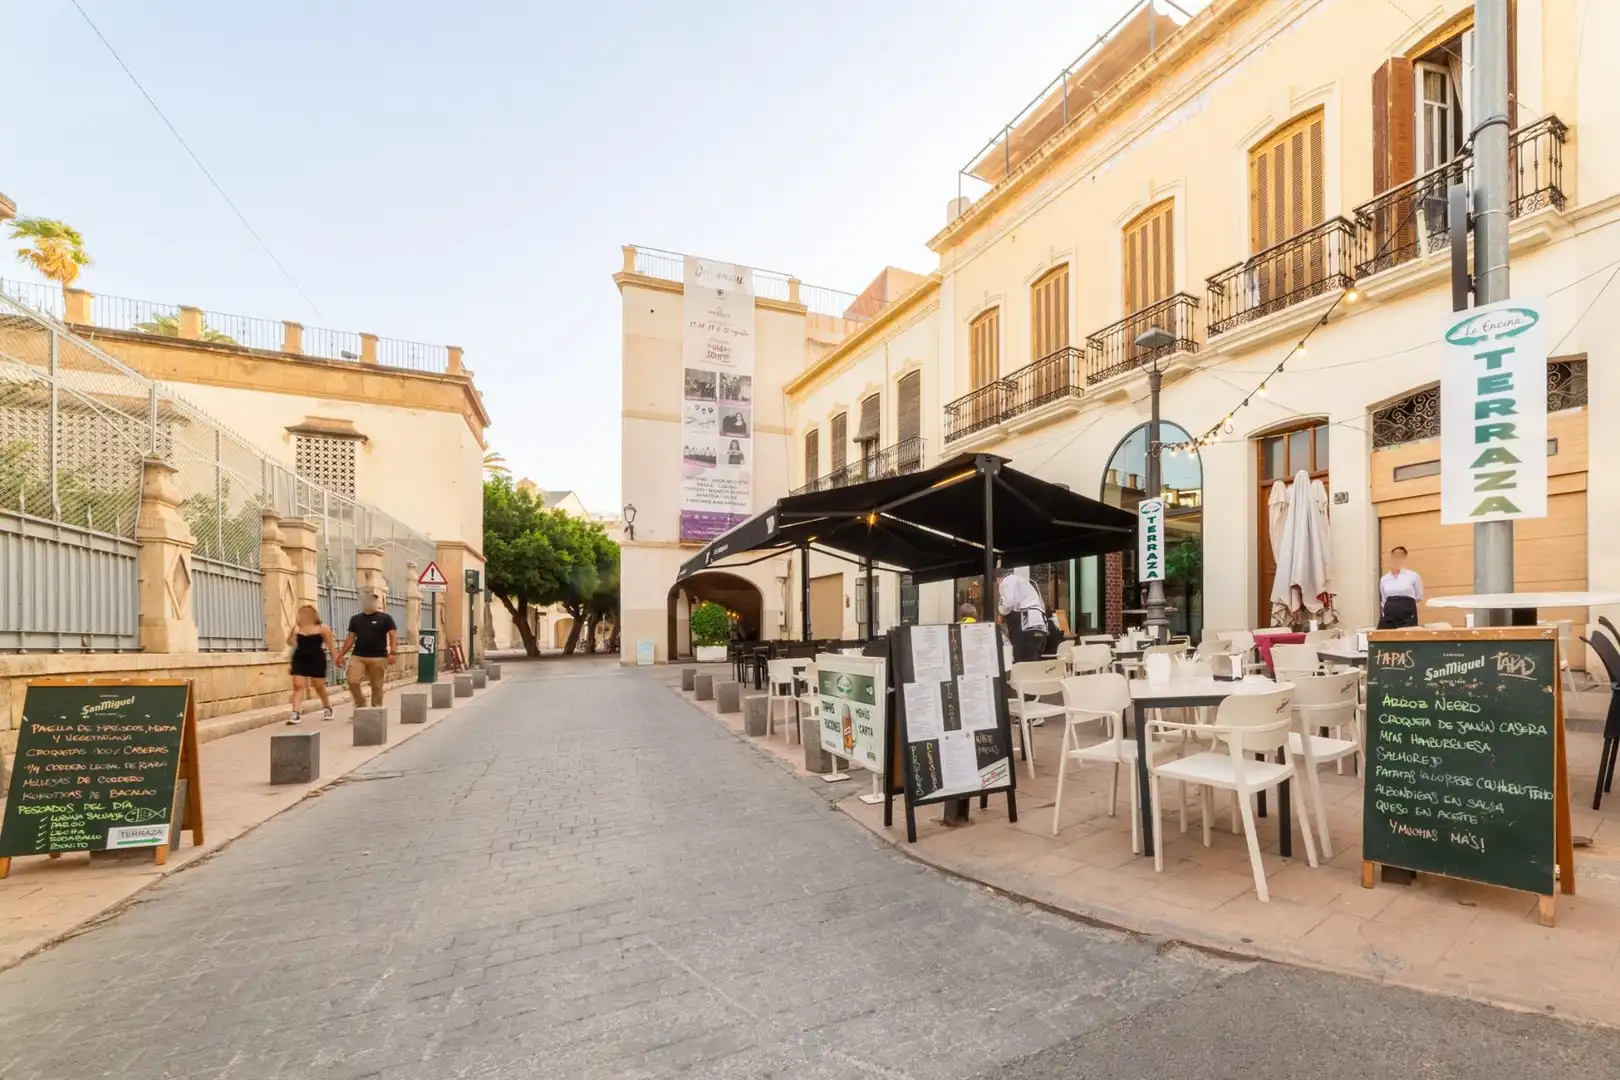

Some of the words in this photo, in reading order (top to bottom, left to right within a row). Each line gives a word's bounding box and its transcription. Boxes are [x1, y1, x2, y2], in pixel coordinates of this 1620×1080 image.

[1464, 325, 1477, 337] La
[1482, 316, 1522, 333] Encina
[1469, 346, 1523, 517] TERRAZA
[1146, 516, 1158, 579] TERRAZA
[1382, 693, 1428, 709] ARROZ
[1435, 697, 1481, 714] NEGRO
[32, 723, 74, 734] PAELLA
[77, 724, 92, 732] DE
[859, 724, 874, 737] CARTA
[1379, 713, 1431, 728] CROQUETA
[1438, 719, 1453, 730] DE
[1500, 722, 1547, 735] CASERA
[53, 735, 60, 743] Y
[1411, 734, 1491, 752] HAMBURGUESA
[25, 749, 87, 757] CROQUETAS
[123, 746, 169, 754] CASERAS
[1376, 747, 1443, 768] SALMOREJO
[77, 776, 92, 784] DE
[97, 776, 144, 784] CORDERO
[1375, 766, 1416, 784] PATATAS
[109, 789, 157, 798] BACALAO
[1376, 800, 1408, 814] QUESO
[1415, 807, 1431, 816] EN
[1444, 796, 1462, 806] EN
[18, 804, 74, 815] PESCADOS
[83, 802, 106, 810] DEL
[120, 829, 163, 838] TERRAZA
